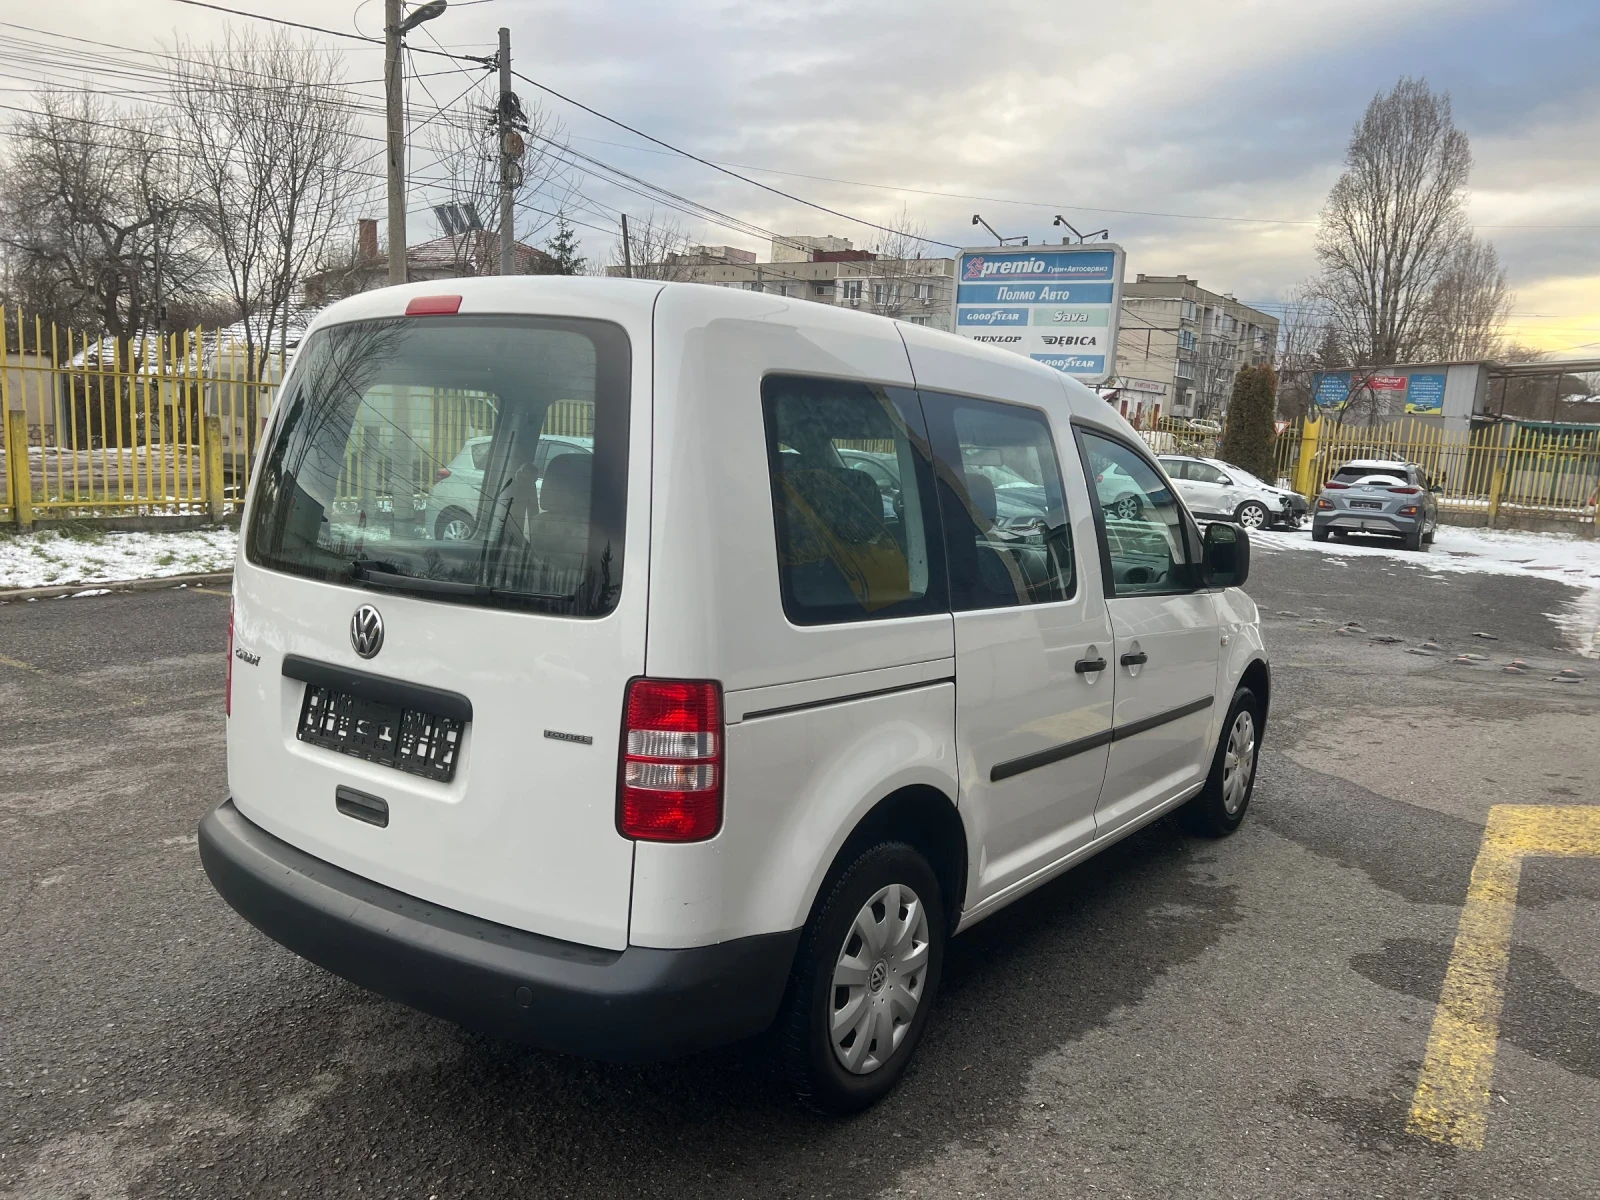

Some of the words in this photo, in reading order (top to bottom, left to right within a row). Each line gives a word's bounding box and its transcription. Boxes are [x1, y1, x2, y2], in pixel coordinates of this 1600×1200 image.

[980, 257, 1046, 278] premio
[996, 286, 1036, 301] Полмо
[1039, 286, 1070, 300] Авто
[1053, 311, 1089, 323] Sava
[973, 335, 1022, 343] DUNLOP
